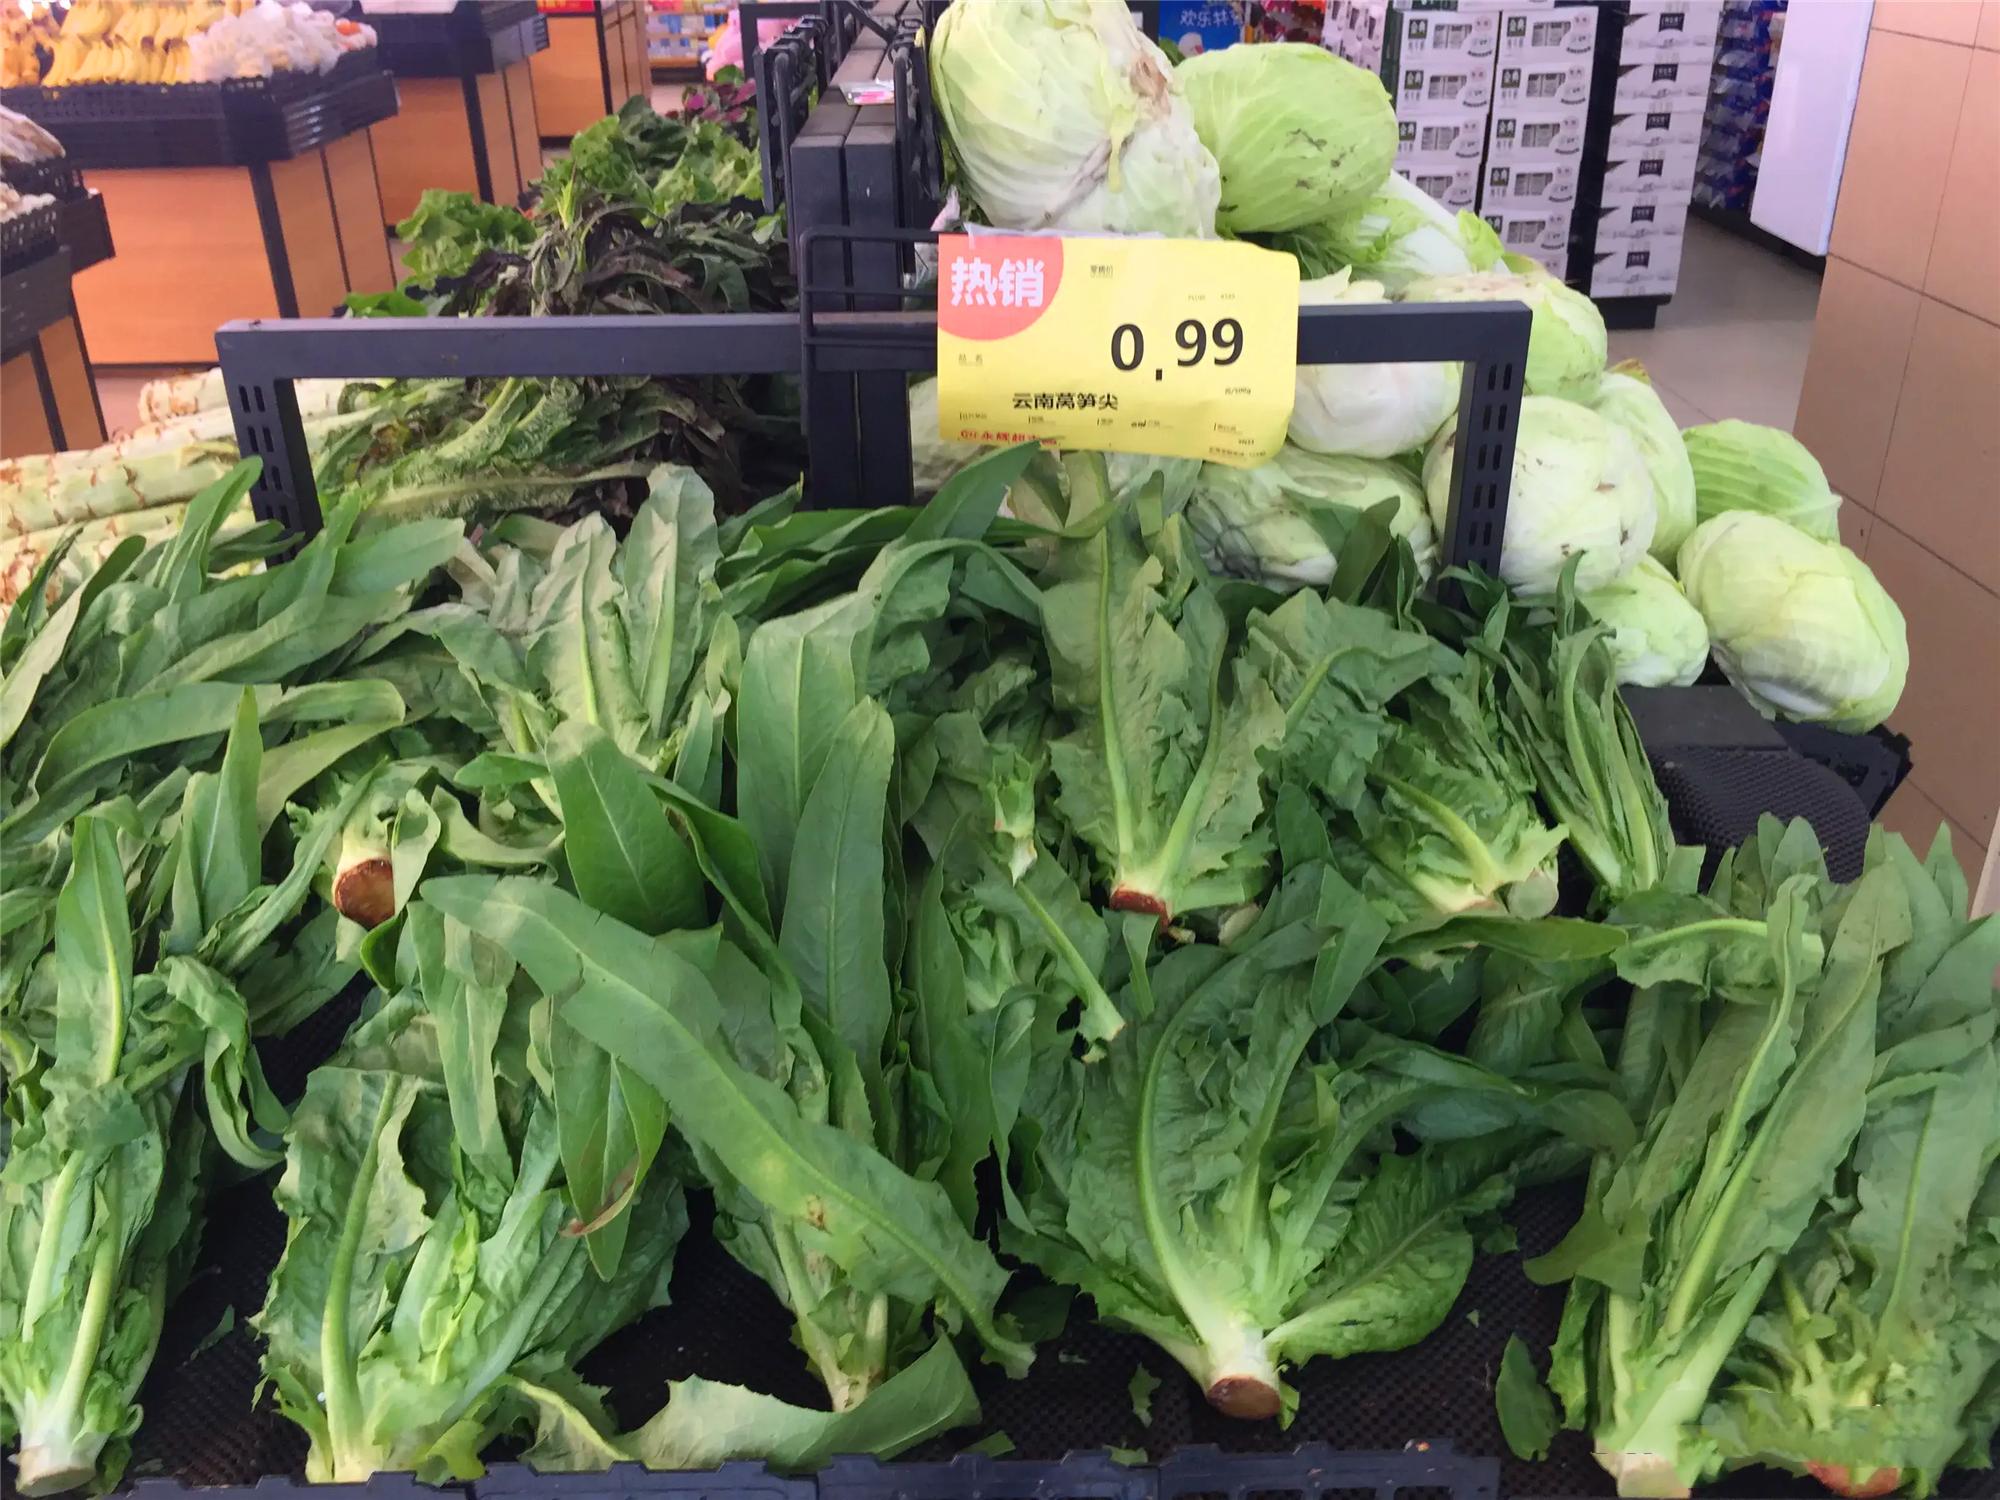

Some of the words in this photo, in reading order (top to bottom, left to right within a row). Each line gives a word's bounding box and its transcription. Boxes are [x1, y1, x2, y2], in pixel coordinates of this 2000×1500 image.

[950, 256, 1045, 308] 热销
[1110, 317, 1244, 382] 0.99
[1012, 392, 1119, 411] 云南莴笋尖
